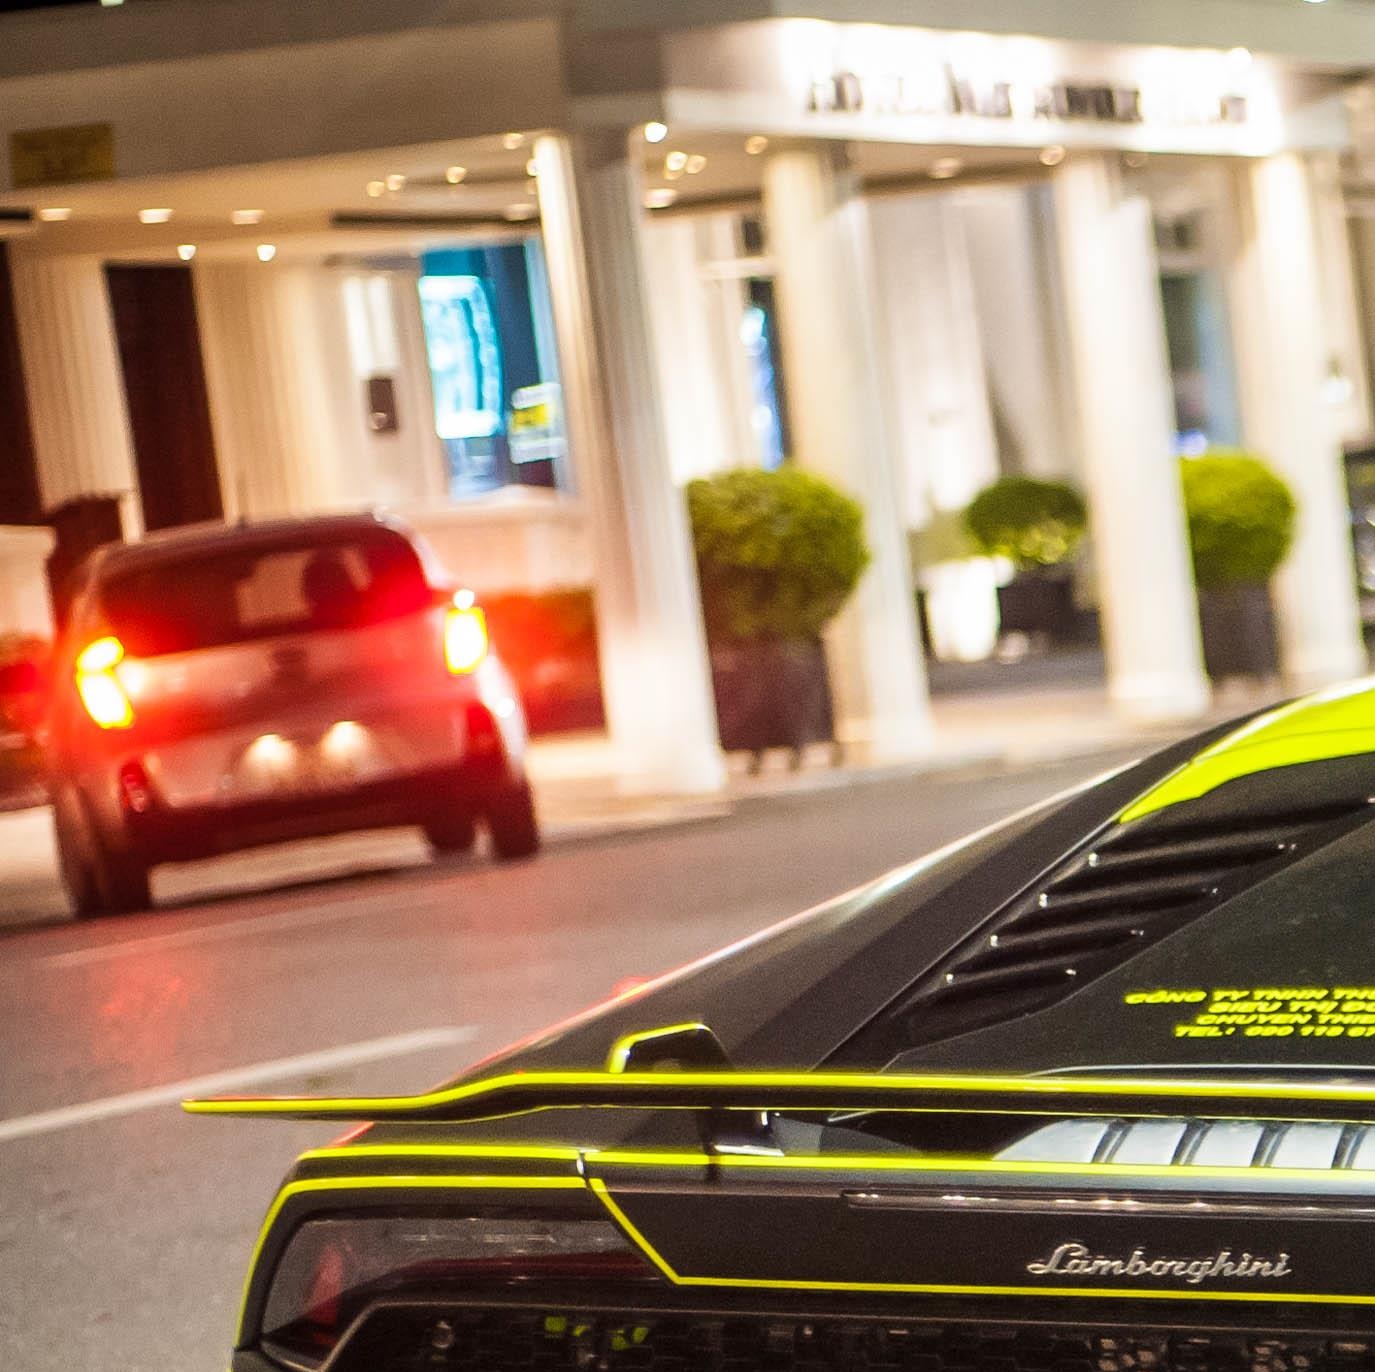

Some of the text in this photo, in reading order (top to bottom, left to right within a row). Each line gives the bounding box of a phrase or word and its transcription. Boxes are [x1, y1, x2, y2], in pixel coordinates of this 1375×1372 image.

[1213, 990, 1249, 1001] TY
[1253, 989, 1328, 1000] TNHH
[1026, 1240, 1292, 1284] Lamborghini
